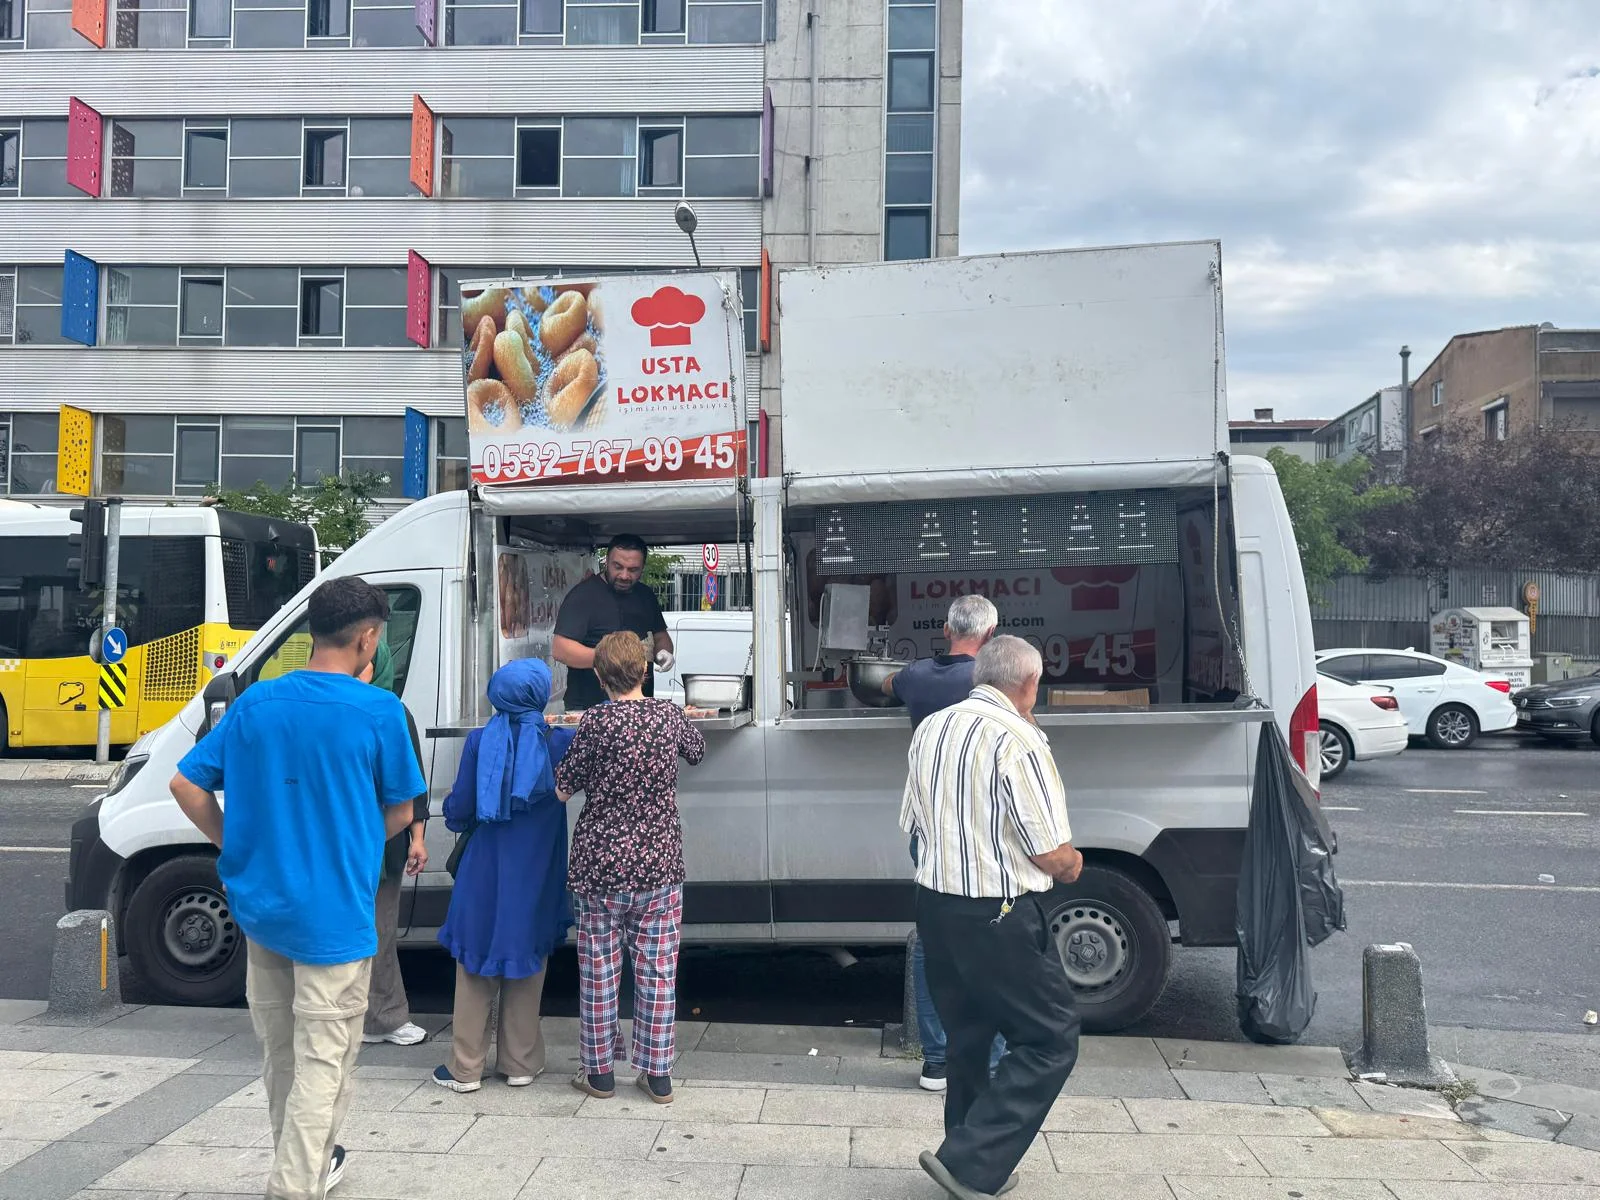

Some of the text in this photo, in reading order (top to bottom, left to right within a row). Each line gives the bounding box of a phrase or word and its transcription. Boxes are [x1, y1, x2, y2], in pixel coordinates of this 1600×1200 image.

[641, 356, 701, 375] USTA
[617, 382, 729, 404] LOKMACI
[483, 434, 735, 479] 0532 767 99 45
[705, 546, 716, 562] 30
[910, 577, 1041, 599] LOKMACI
[1084, 632, 1136, 676] 45
